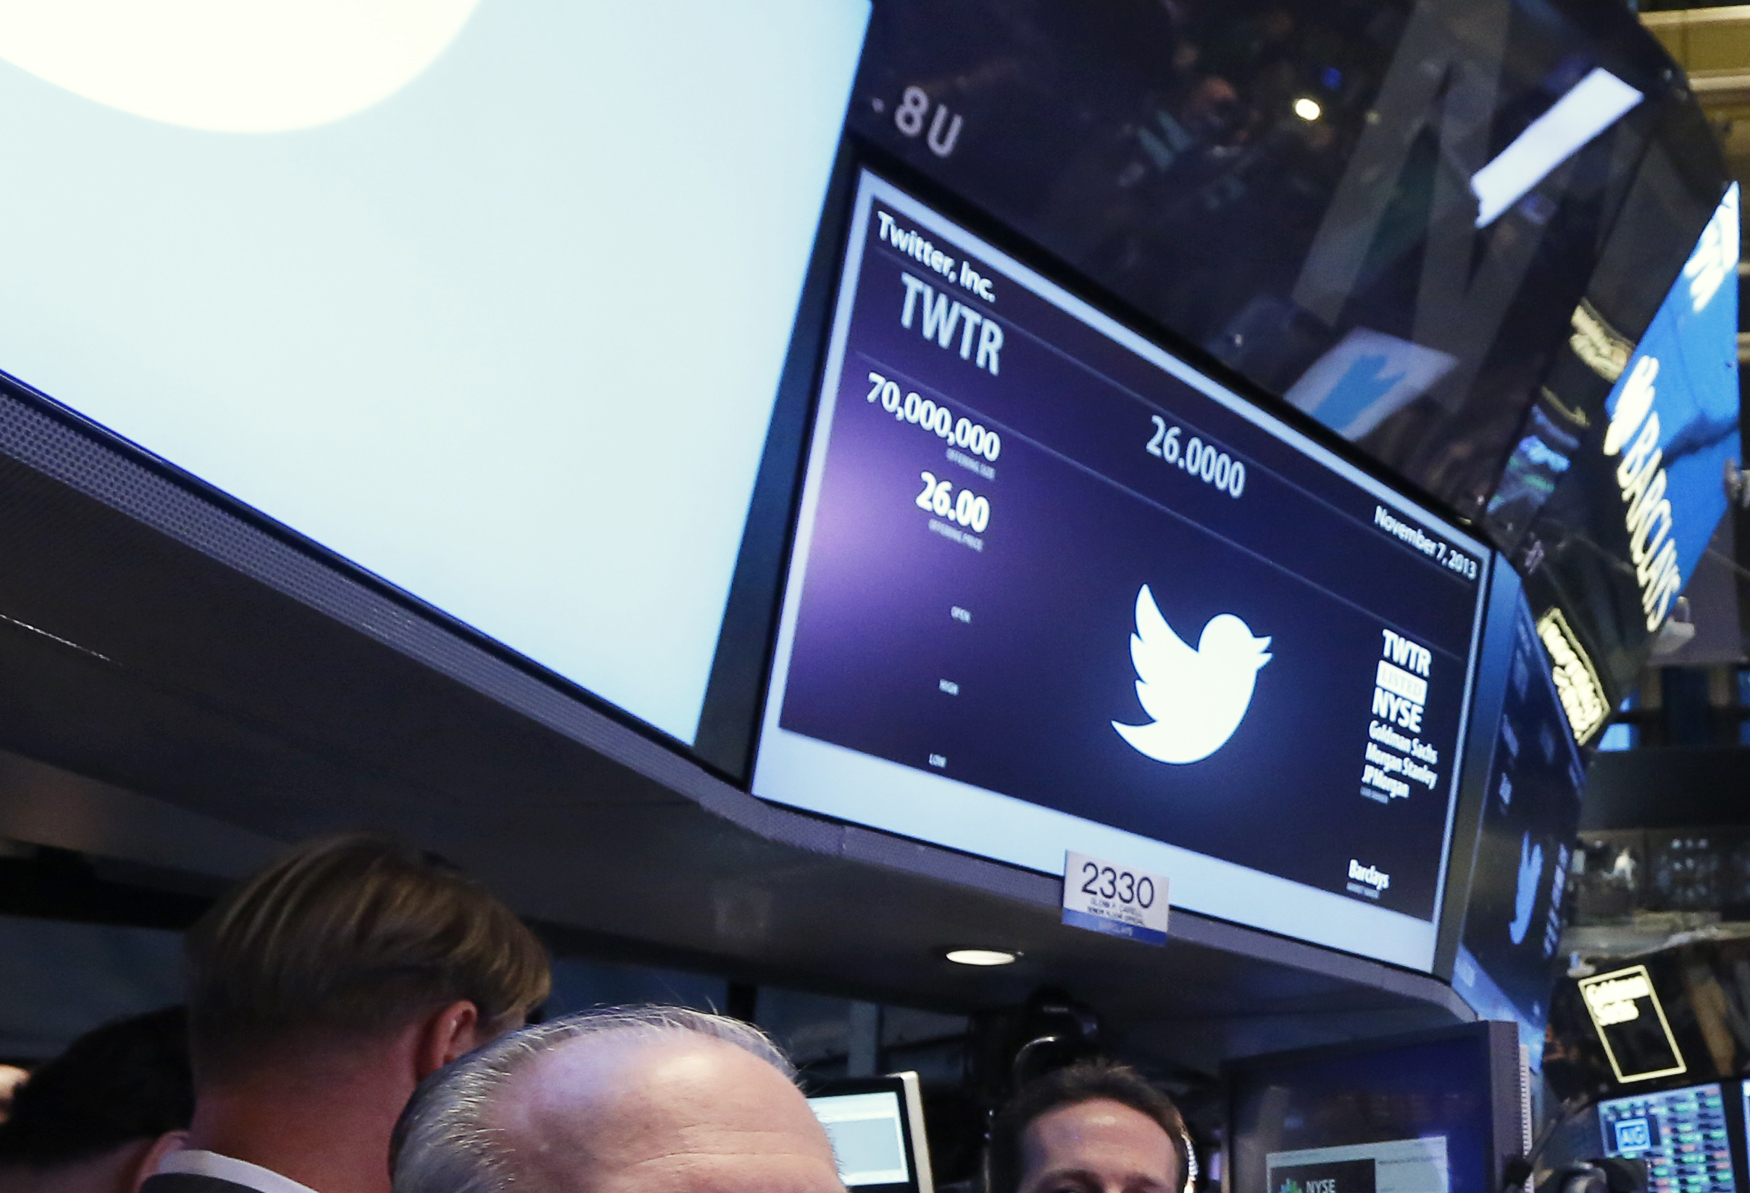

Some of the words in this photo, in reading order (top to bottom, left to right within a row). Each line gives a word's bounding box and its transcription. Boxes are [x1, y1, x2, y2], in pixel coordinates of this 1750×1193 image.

[877, 210, 957, 283] Twitter,
[959, 260, 996, 302] Inc.
[900, 271, 1004, 377] TWTR
[866, 371, 1001, 462] 70,000,000
[1146, 415, 1246, 499] 26.0000
[915, 470, 990, 533] 26.00
[1374, 505, 1438, 558] November
[1449, 550, 1478, 580] 2013
[1382, 628, 1432, 678] TWTR
[1368, 719, 1412, 754] Goldman
[1371, 686, 1424, 734] NYSE
[1365, 742, 1403, 773] Morgan
[1402, 757, 1438, 790] Stanley
[1081, 861, 1155, 909] 2330
[1348, 858, 1390, 891] Barclays
